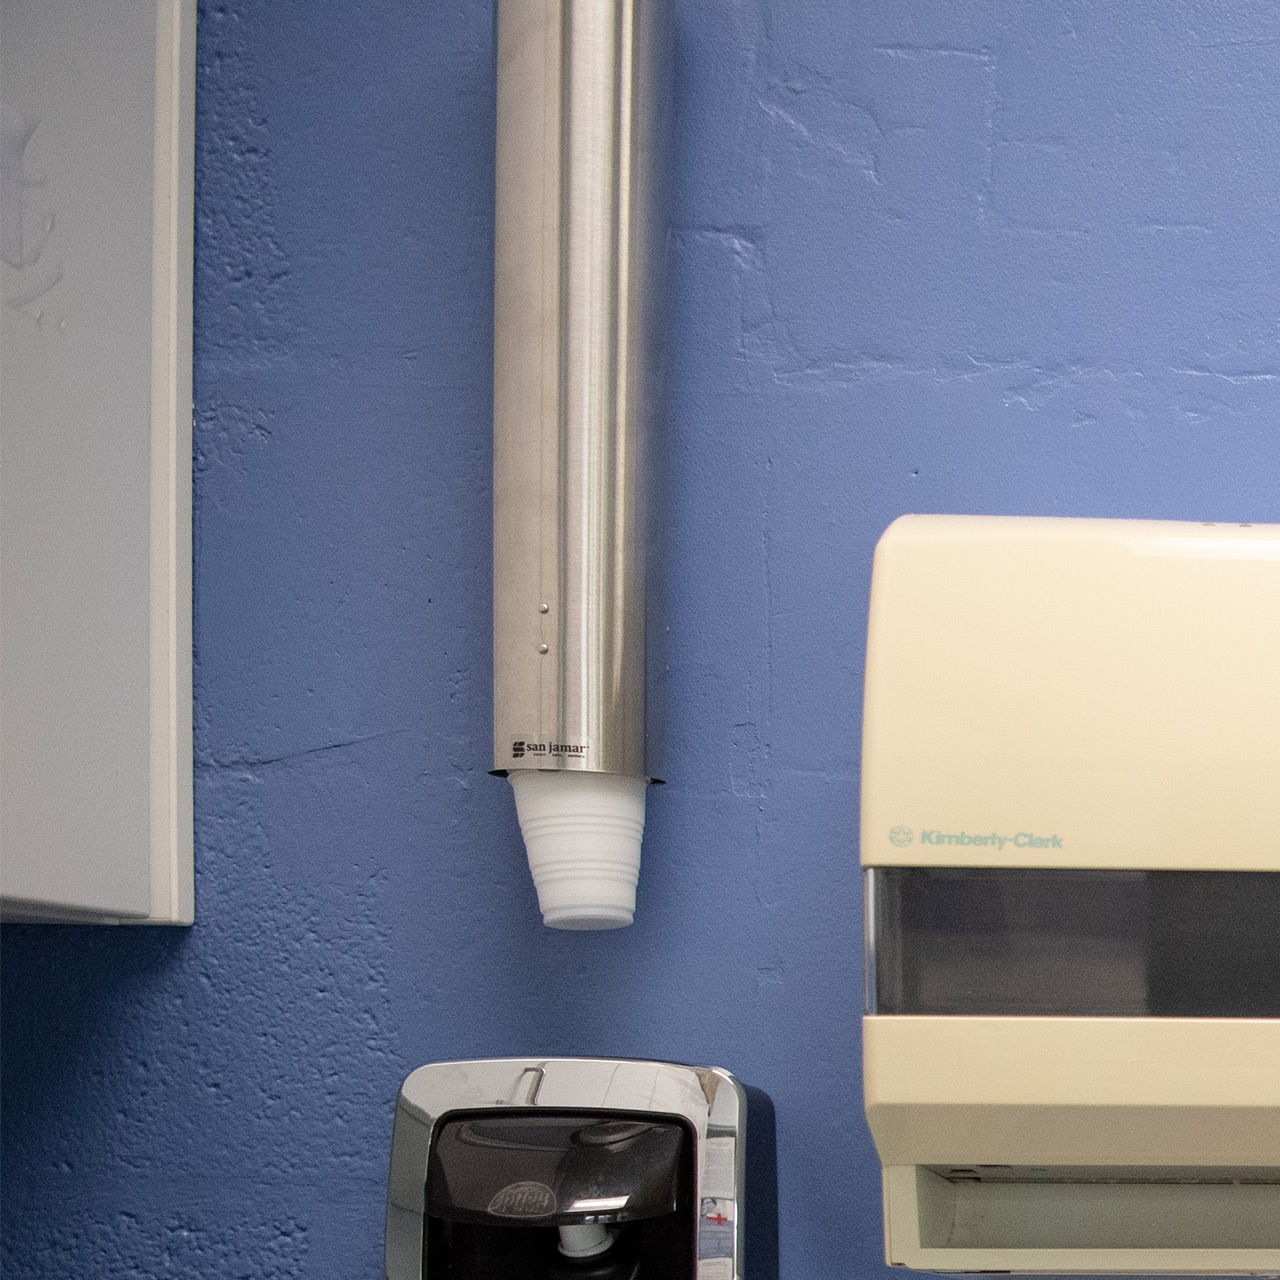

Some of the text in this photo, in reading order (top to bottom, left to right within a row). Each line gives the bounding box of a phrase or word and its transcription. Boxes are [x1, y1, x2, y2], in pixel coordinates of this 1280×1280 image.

[527, 742, 586, 754] san jamar
[921, 830, 1063, 849] Kimberly-Clark
